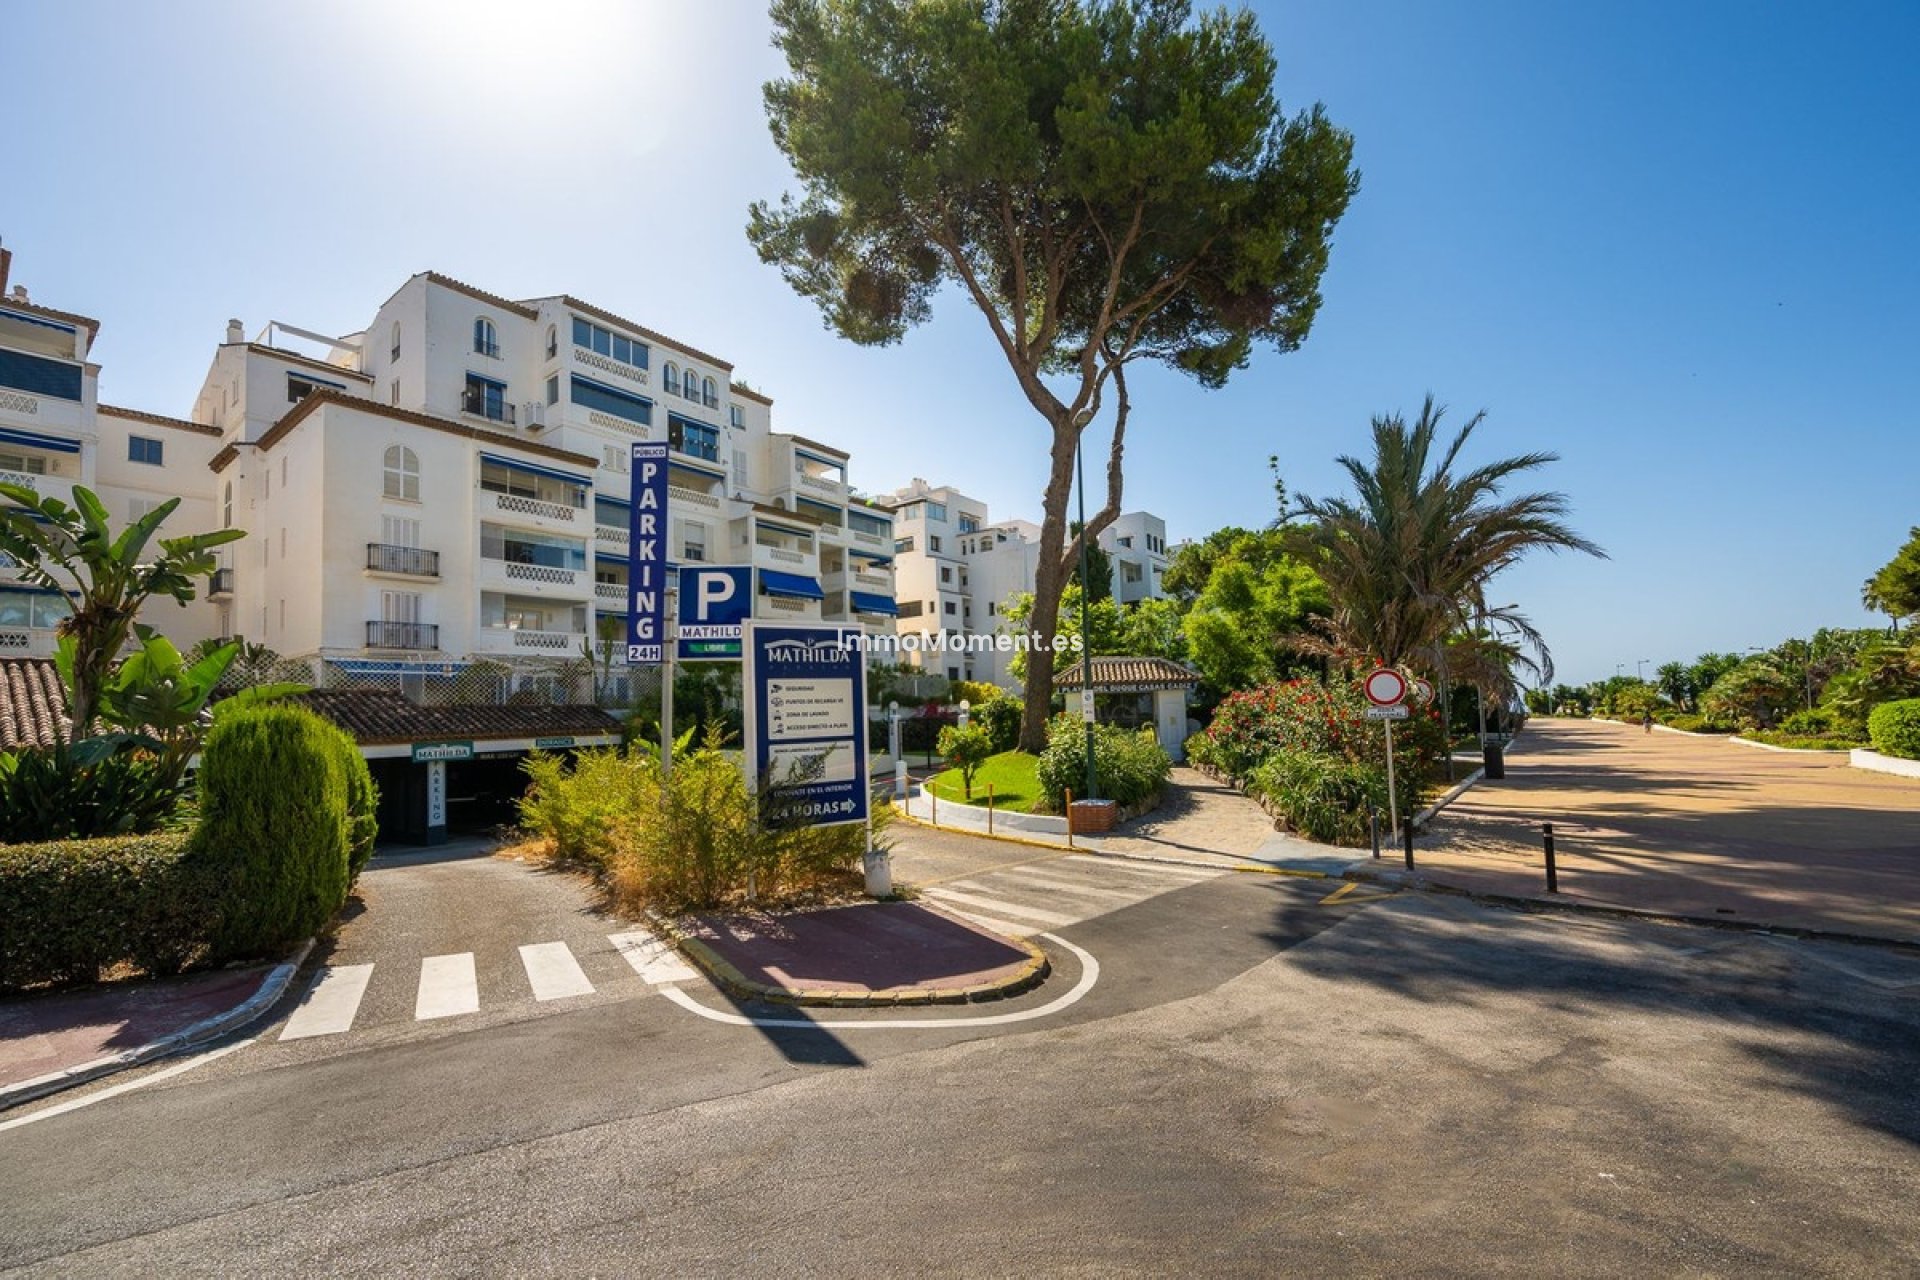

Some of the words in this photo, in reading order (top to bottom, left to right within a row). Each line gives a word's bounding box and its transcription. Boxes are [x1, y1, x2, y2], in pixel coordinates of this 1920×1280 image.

[636, 462, 658, 640] PARKING
[697, 572, 736, 621] P
[630, 647, 659, 660] 24H
[768, 647, 850, 663] MATHILDA
